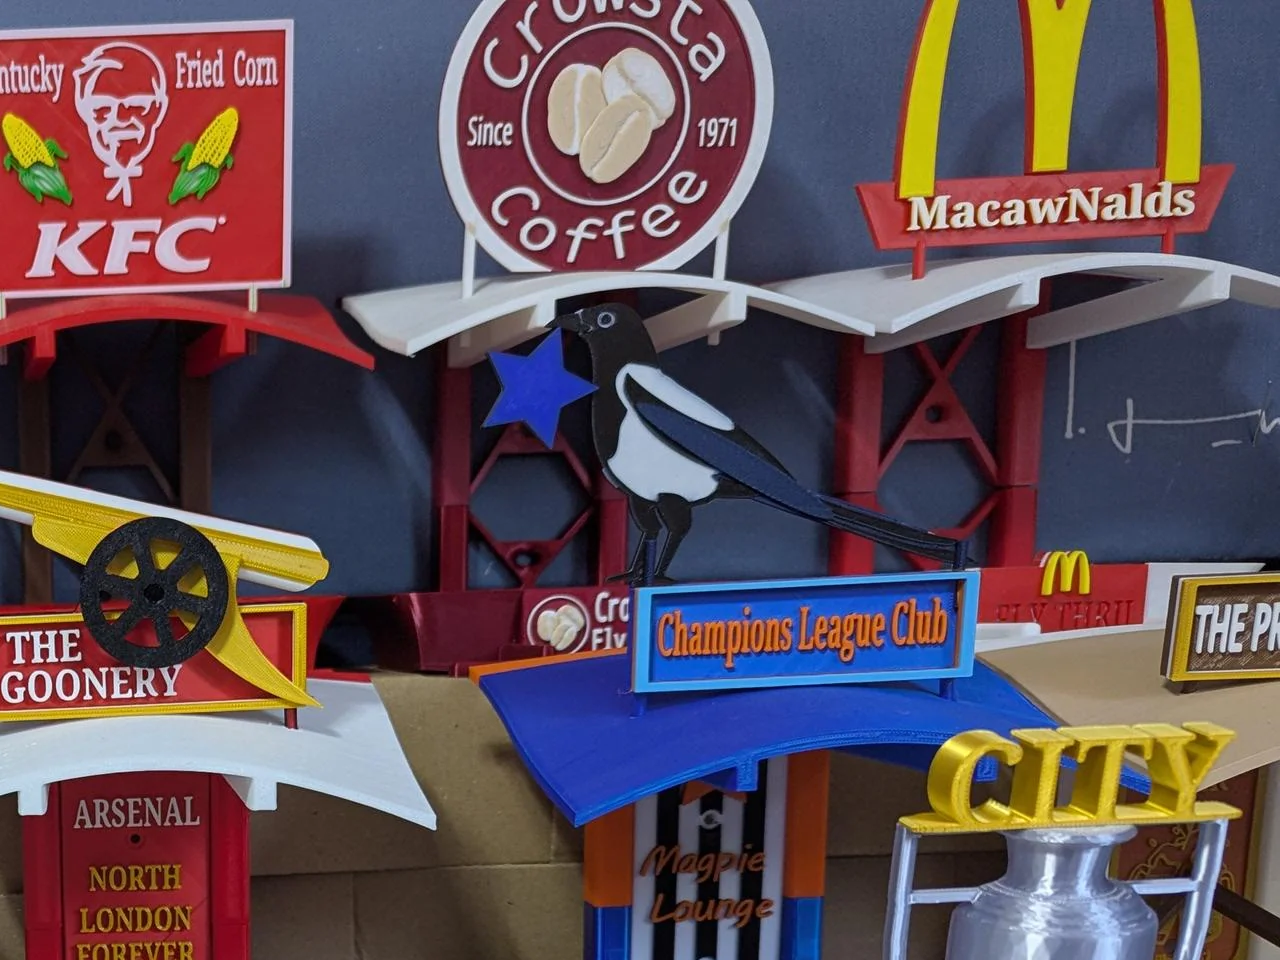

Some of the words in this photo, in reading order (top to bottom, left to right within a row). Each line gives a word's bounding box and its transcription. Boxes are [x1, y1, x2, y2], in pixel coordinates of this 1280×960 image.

[175, 50, 225, 89] Fried
[233, 50, 278, 87] Corn
[467, 116, 514, 148] Since
[697, 117, 738, 148] 1971
[491, 171, 708, 263] Coffee
[905, 180, 1196, 232] MacawNalds
[24, 216, 218, 279] KFC
[6, 629, 81, 664] THE
[657, 604, 793, 668] Champions
[799, 606, 886, 663] League
[891, 597, 948, 647] Club
[1195, 603, 1248, 654] THE
[0, 664, 183, 704] GOONERY
[927, 722, 1236, 826] CITY
[73, 796, 201, 829] ARSENAL
[89, 864, 182, 892] NORTH
[639, 844, 766, 884] Magpie
[79, 906, 193, 933] LONDON
[651, 893, 775, 928] Lounge
